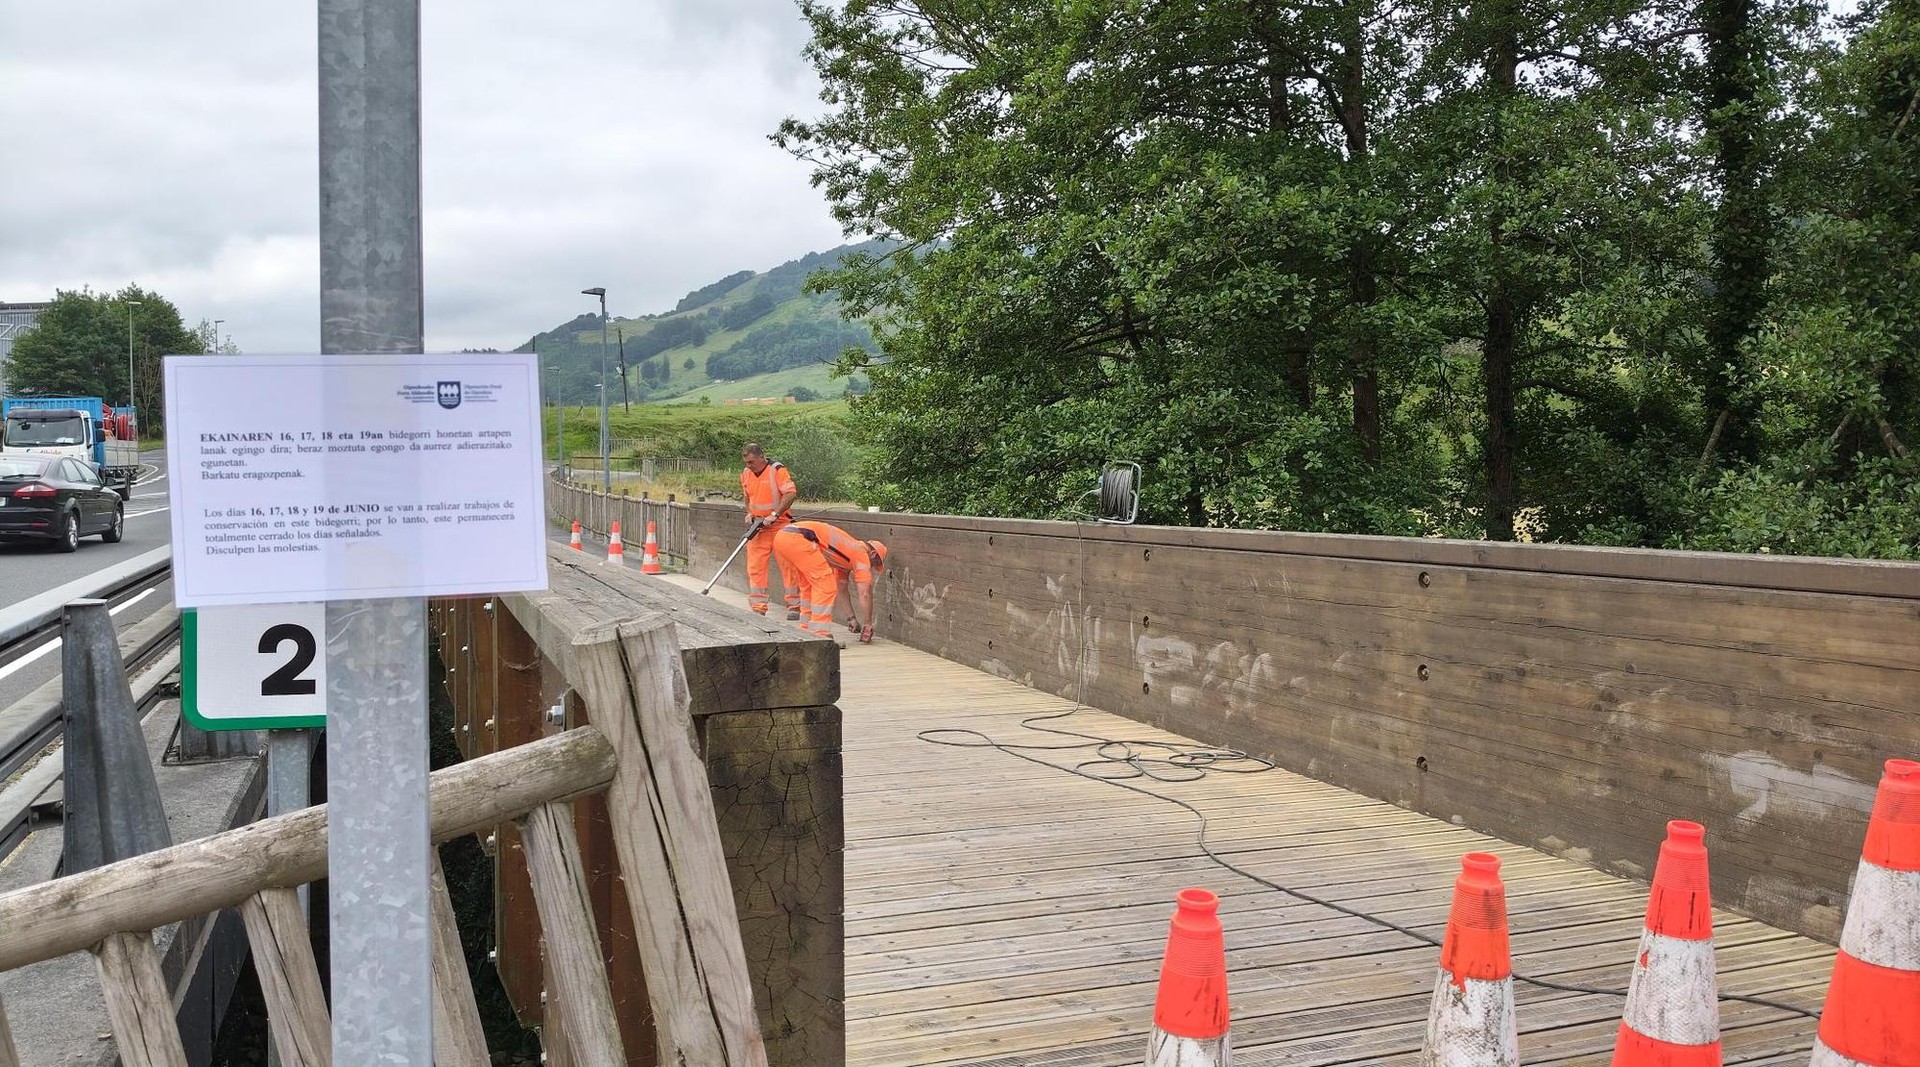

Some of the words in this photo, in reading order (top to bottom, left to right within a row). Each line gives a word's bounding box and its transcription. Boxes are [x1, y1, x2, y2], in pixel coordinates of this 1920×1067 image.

[200, 432, 273, 442] EKAINAREN
[280, 431, 295, 442] 16,
[301, 431, 315, 442] 17,
[321, 431, 333, 440] 18
[338, 432, 354, 440] eta
[360, 430, 383, 440] 19an
[389, 430, 431, 441] bidegorri
[436, 429, 473, 439] honetan
[478, 430, 512, 440] artapen
[200, 446, 227, 455] lanak
[232, 446, 265, 456] egingo
[270, 445, 292, 455] dira;
[297, 444, 323, 453] beraz
[328, 444, 366, 453] moztuta
[370, 444, 405, 454] egongo
[409, 442, 421, 450] da
[457, 441, 512, 450] adierazitako
[200, 458, 247, 469] egunetan.
[201, 470, 240, 480] Barkatu
[242, 469, 305, 480] eragozpenak.
[204, 508, 223, 518] Los
[226, 507, 246, 517] días
[250, 507, 265, 517] 16,
[269, 506, 284, 516] 17,
[288, 506, 299, 515] 18
[302, 507, 308, 516] y
[313, 505, 324, 514] 19
[328, 505, 340, 514] de
[343, 504, 380, 514] JUNIO
[383, 504, 394, 512] se
[397, 504, 415, 512] van
[426, 501, 461, 511] realizar
[464, 500, 500, 511] trabajos
[503, 500, 515, 509] de
[204, 521, 268, 530] conservación
[291, 519, 310, 527] este
[315, 517, 361, 529] bidegorri;
[366, 517, 382, 527] por
[388, 515, 397, 525] lo
[402, 516, 428, 526] tanto,
[433, 515, 452, 523] este
[457, 513, 515, 525] permanecerá
[205, 533, 256, 542] totalmente
[258, 531, 295, 540] cerrado
[297, 530, 311, 539] los
[313, 529, 333, 539] días
[335, 528, 382, 539] señalados.
[206, 545, 255, 556] Disculpen
[257, 544, 271, 553] las
[273, 543, 321, 552] molestias.
[258, 623, 317, 696] 2
